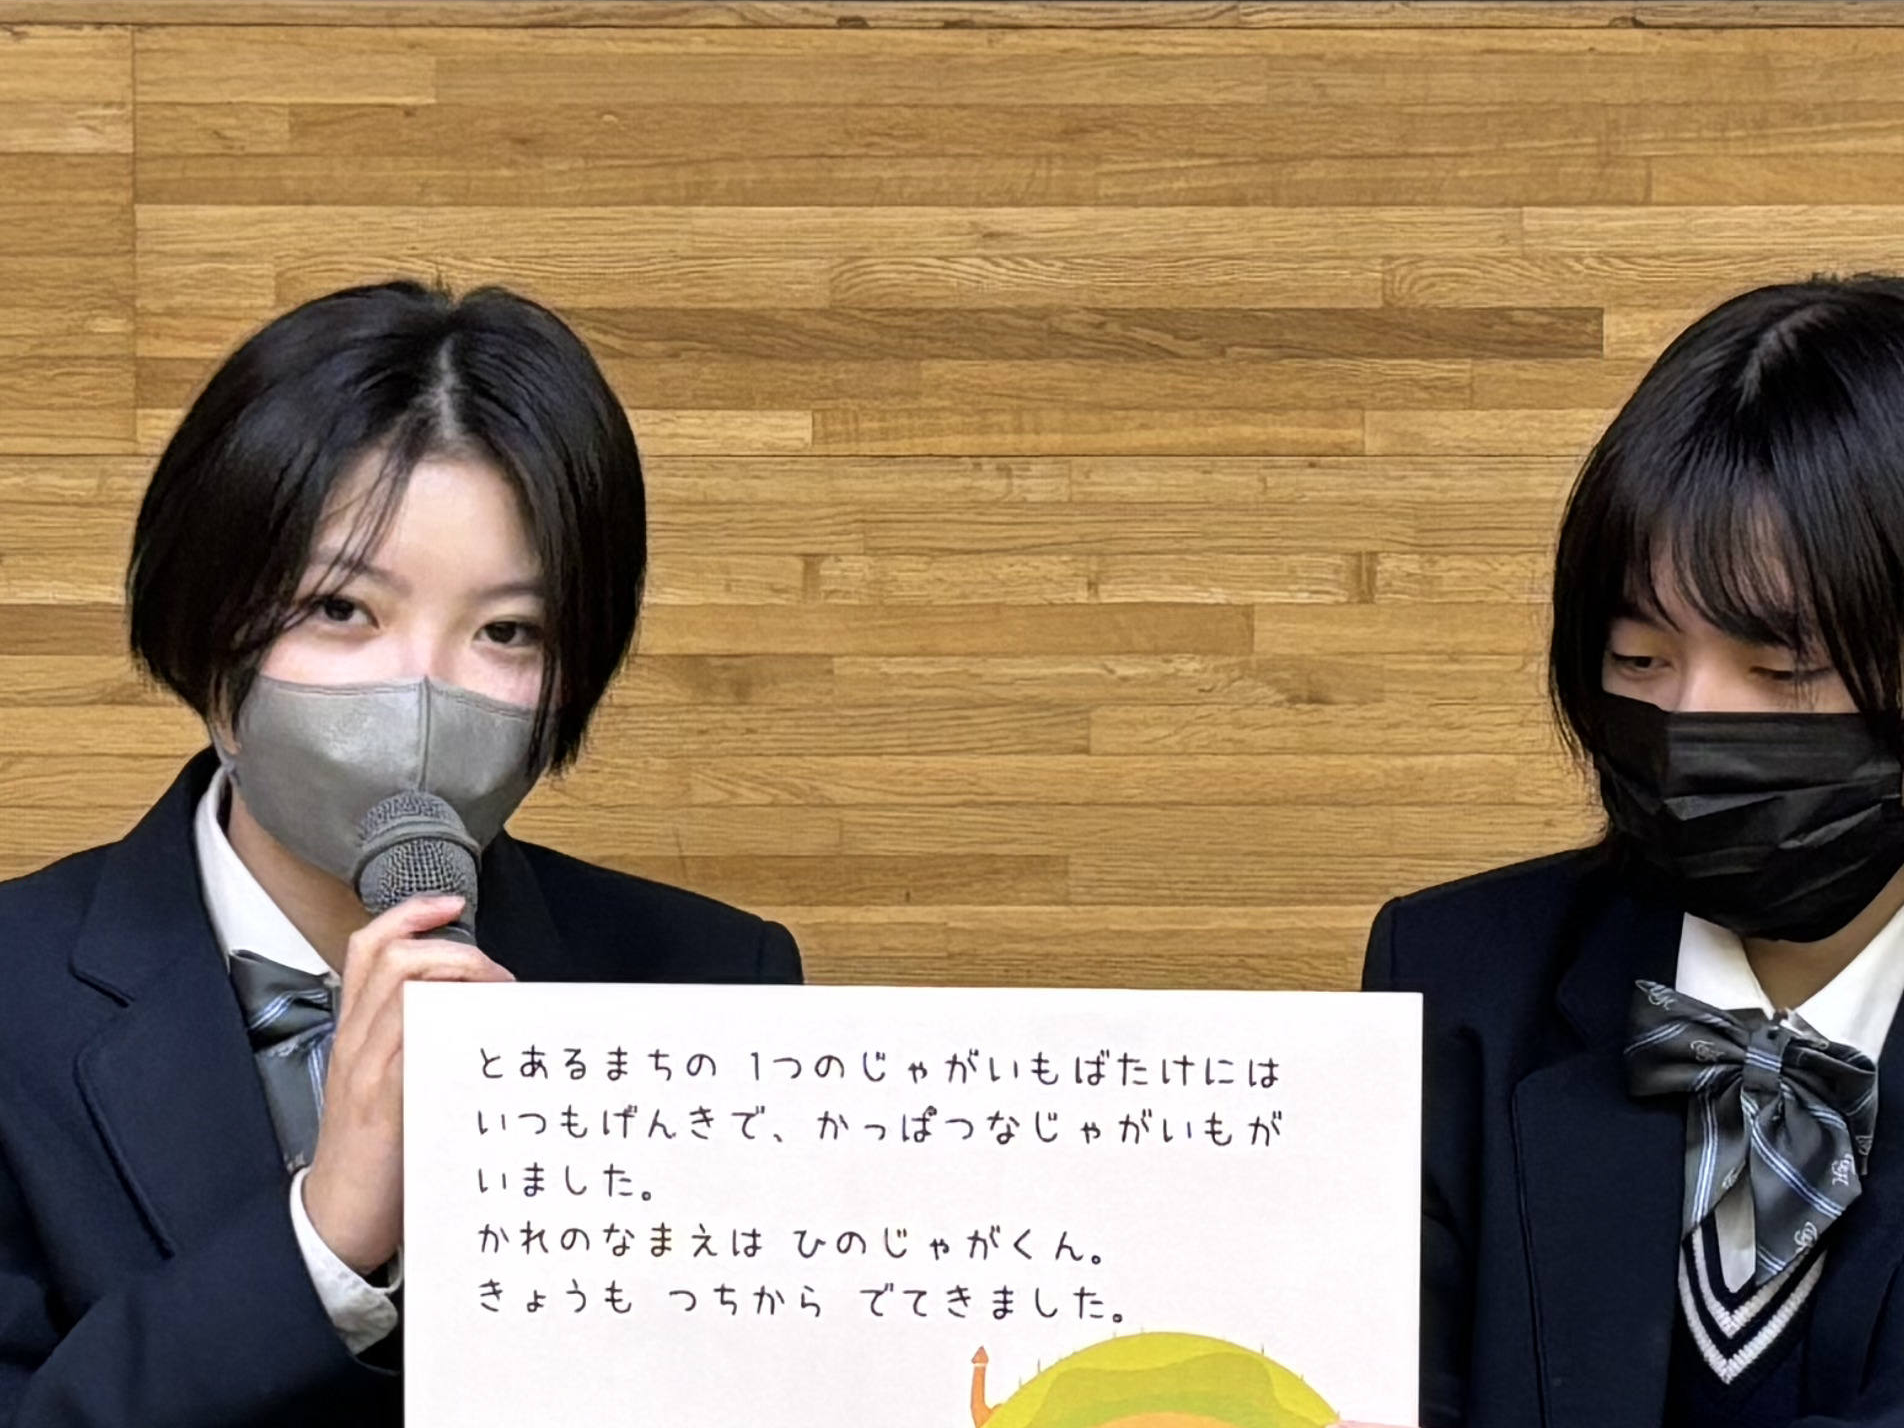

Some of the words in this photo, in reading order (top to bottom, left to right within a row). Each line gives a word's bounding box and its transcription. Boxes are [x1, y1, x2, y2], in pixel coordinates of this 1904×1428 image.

[481, 1045, 716, 1081] とあるまちの
[751, 1049, 1279, 1088] 1つのじゃがいもばたけには
[479, 1163, 651, 1202] いました。
[479, 1221, 762, 1257] かれのなまえは
[794, 1225, 1102, 1265] ひのじゃがくん。
[481, 1279, 632, 1314] きょうも
[670, 1284, 821, 1318] つちから
[860, 1283, 1123, 1324] でてきました。
